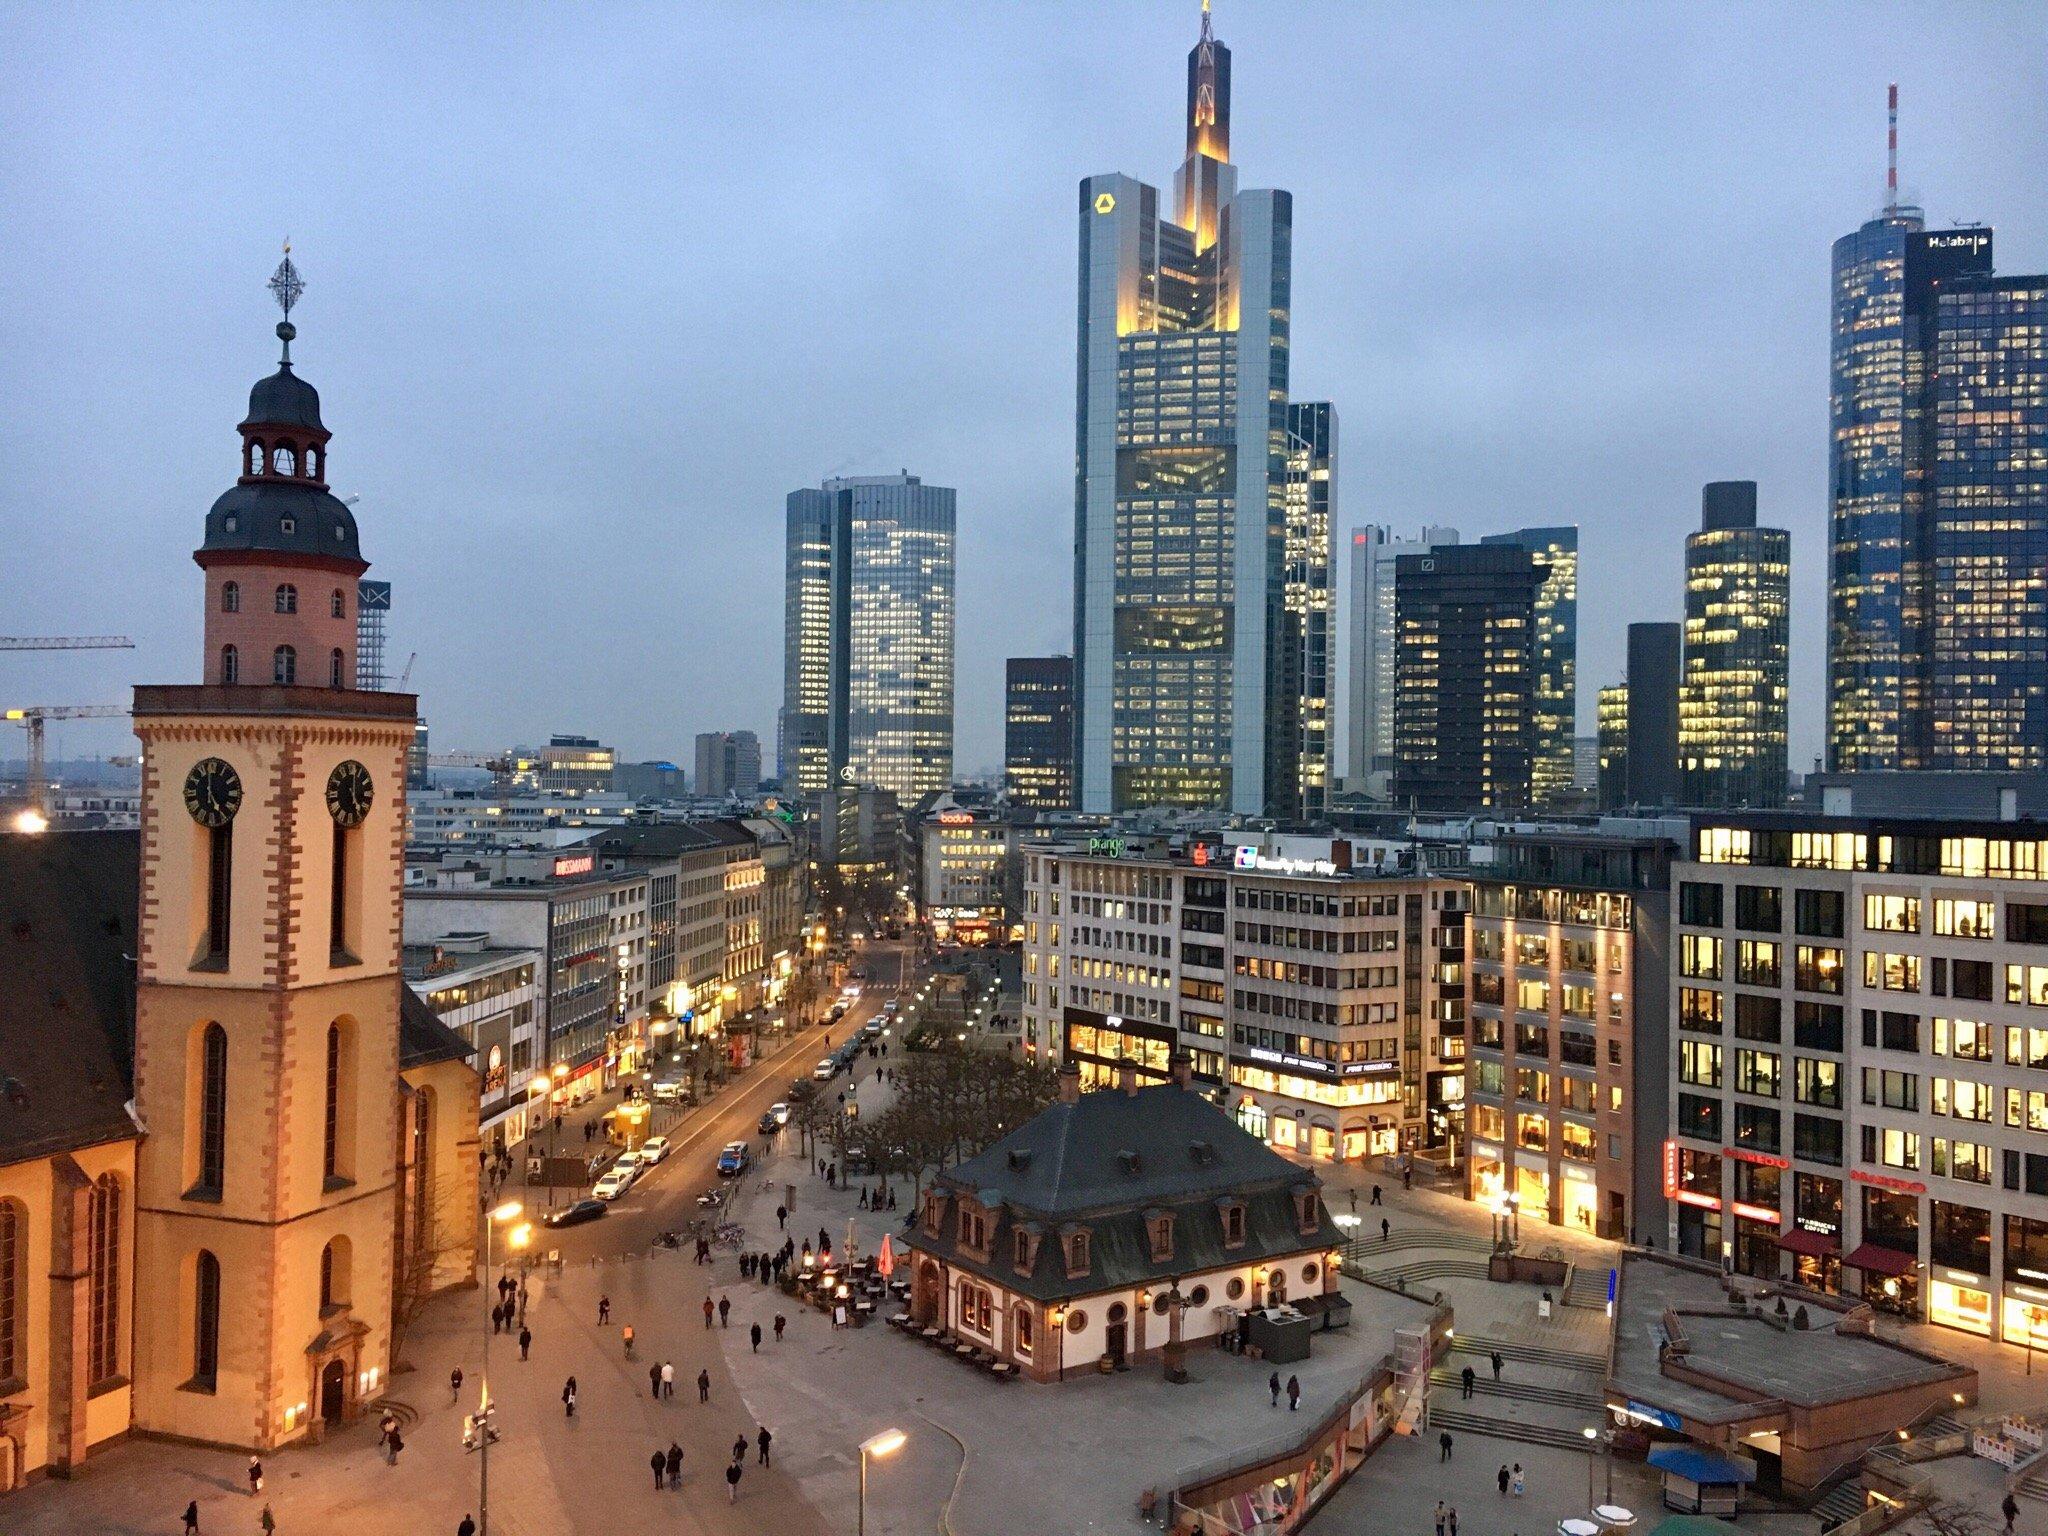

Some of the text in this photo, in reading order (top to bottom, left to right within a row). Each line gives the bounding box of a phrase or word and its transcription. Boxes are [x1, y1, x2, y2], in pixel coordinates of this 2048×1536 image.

[1929, 234, 1973, 248] Helaba
[941, 813, 973, 824] bodum
[1089, 838, 1126, 859] prange
[1797, 1216, 1837, 1231] STARBUCKS
[1803, 1224, 1829, 1235] COFFEE
